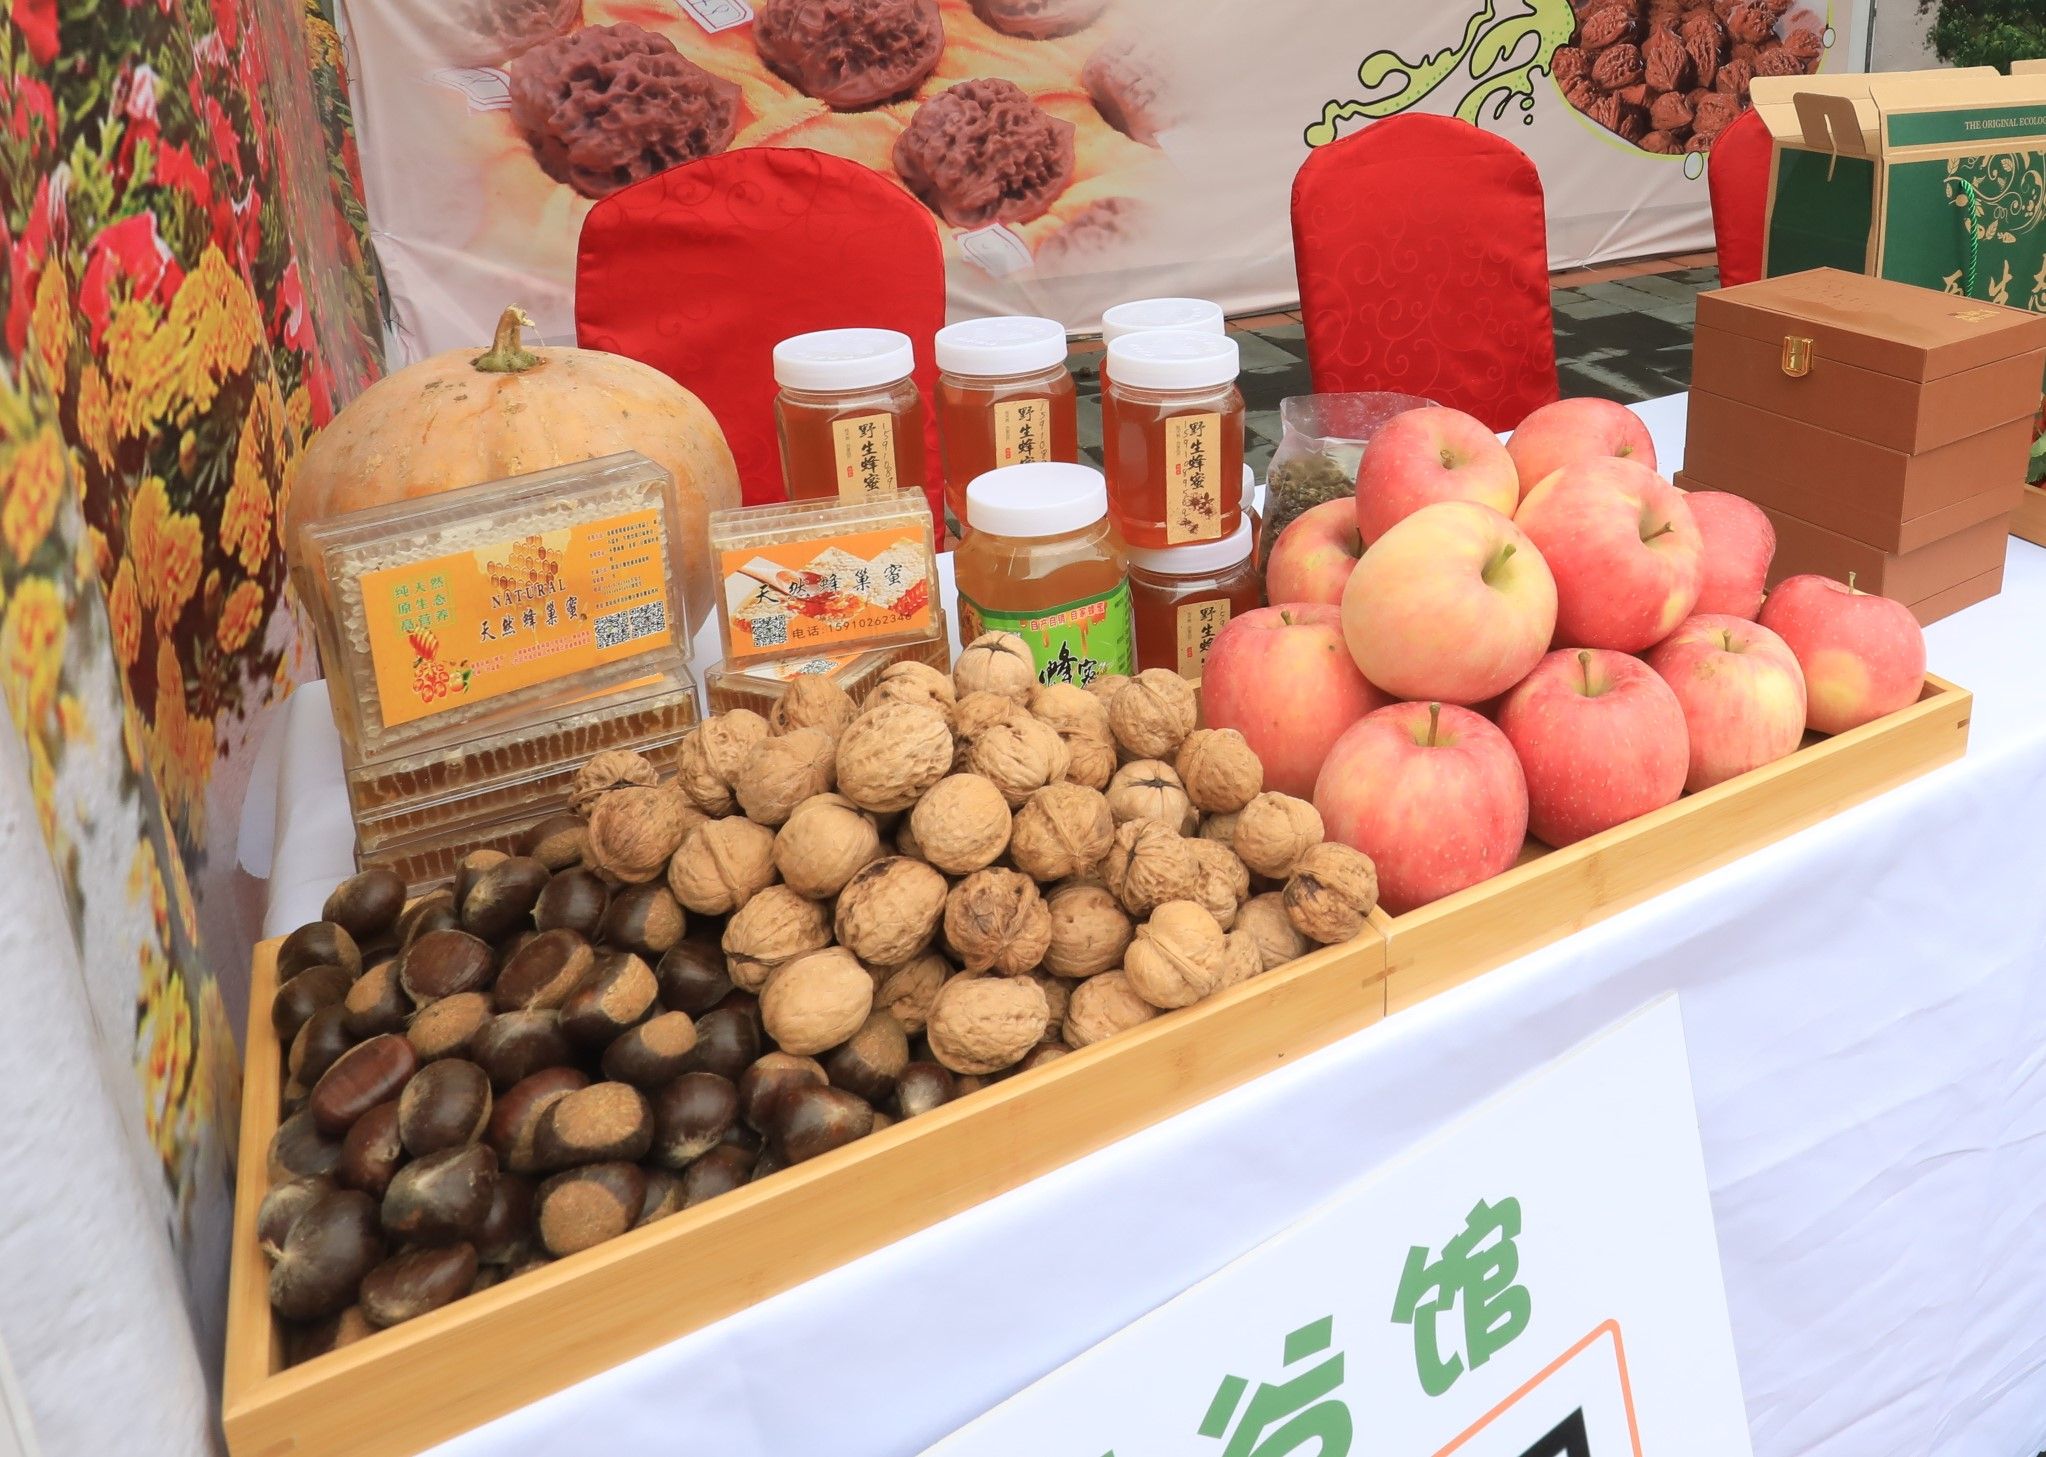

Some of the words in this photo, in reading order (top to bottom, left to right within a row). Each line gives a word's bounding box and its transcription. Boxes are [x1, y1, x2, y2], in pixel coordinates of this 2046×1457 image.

[1965, 121, 1981, 130] THE
[1982, 118, 2018, 129] ORIGINAL
[858, 422, 880, 492] 野生蜂蜜
[1187, 420, 1207, 490] 野生蜂蜜
[492, 578, 566, 609] NATURAL
[754, 563, 902, 605] 天然蜂巢蜜
[480, 595, 577, 641] 天然蜂巢蜜
[1200, 605, 1216, 668] 野生蜂
